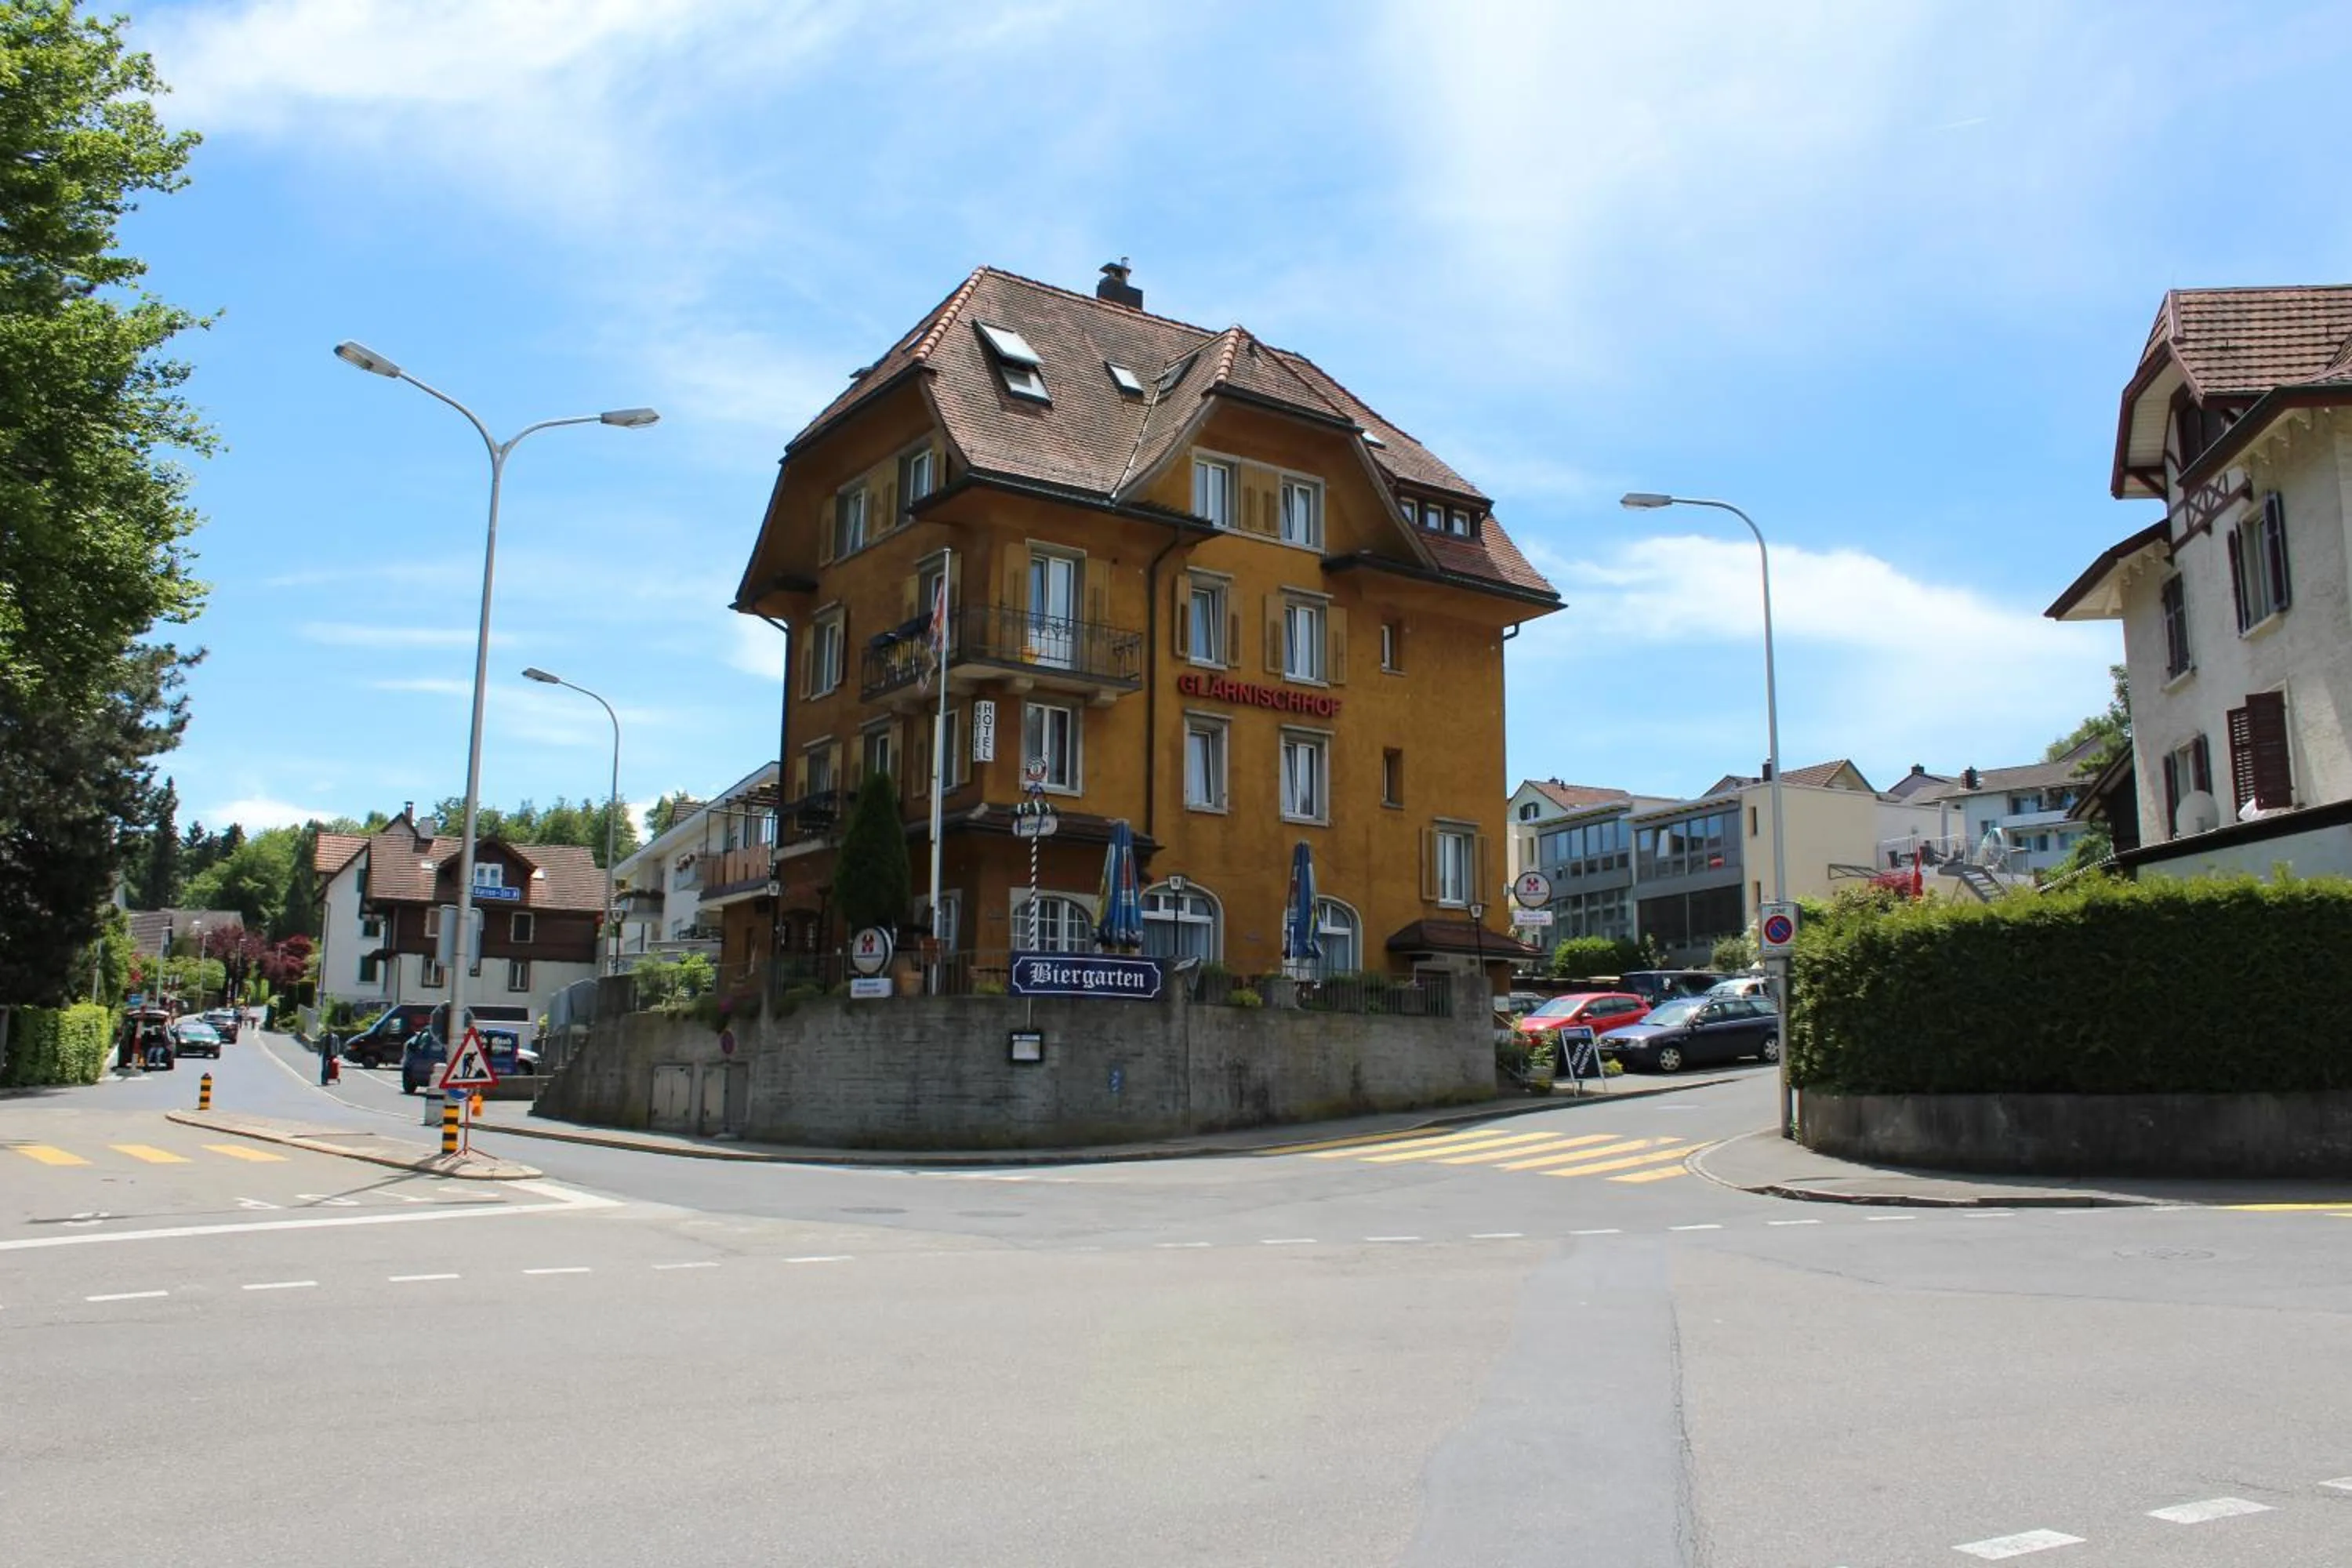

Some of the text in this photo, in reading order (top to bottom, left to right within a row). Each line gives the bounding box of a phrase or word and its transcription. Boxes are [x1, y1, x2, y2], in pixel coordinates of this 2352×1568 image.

[1179, 674, 1342, 717] GLÄRNISCHHOF
[983, 703, 993, 759] HOTEL
[1029, 962, 1145, 989] Biergarten
